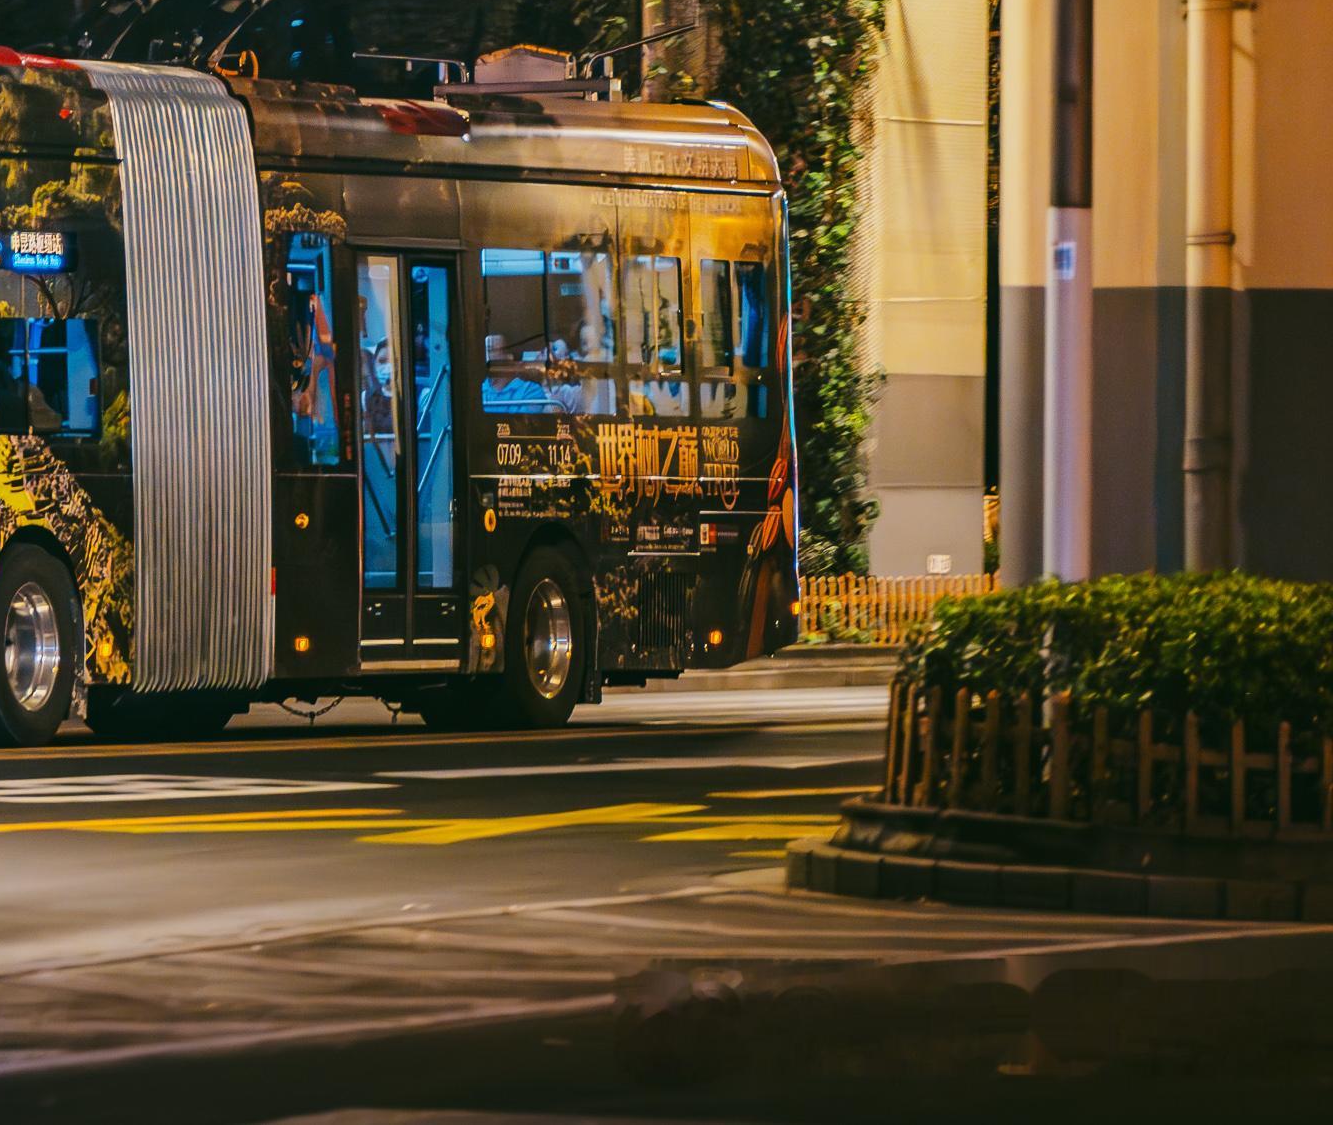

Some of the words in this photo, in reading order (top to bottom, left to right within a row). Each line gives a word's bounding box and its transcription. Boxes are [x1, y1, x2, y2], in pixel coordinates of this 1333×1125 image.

[497, 443, 521, 465] 07.09
[548, 444, 571, 466] 11.14
[702, 438, 740, 462] WORLD
[704, 463, 740, 511] TREE
